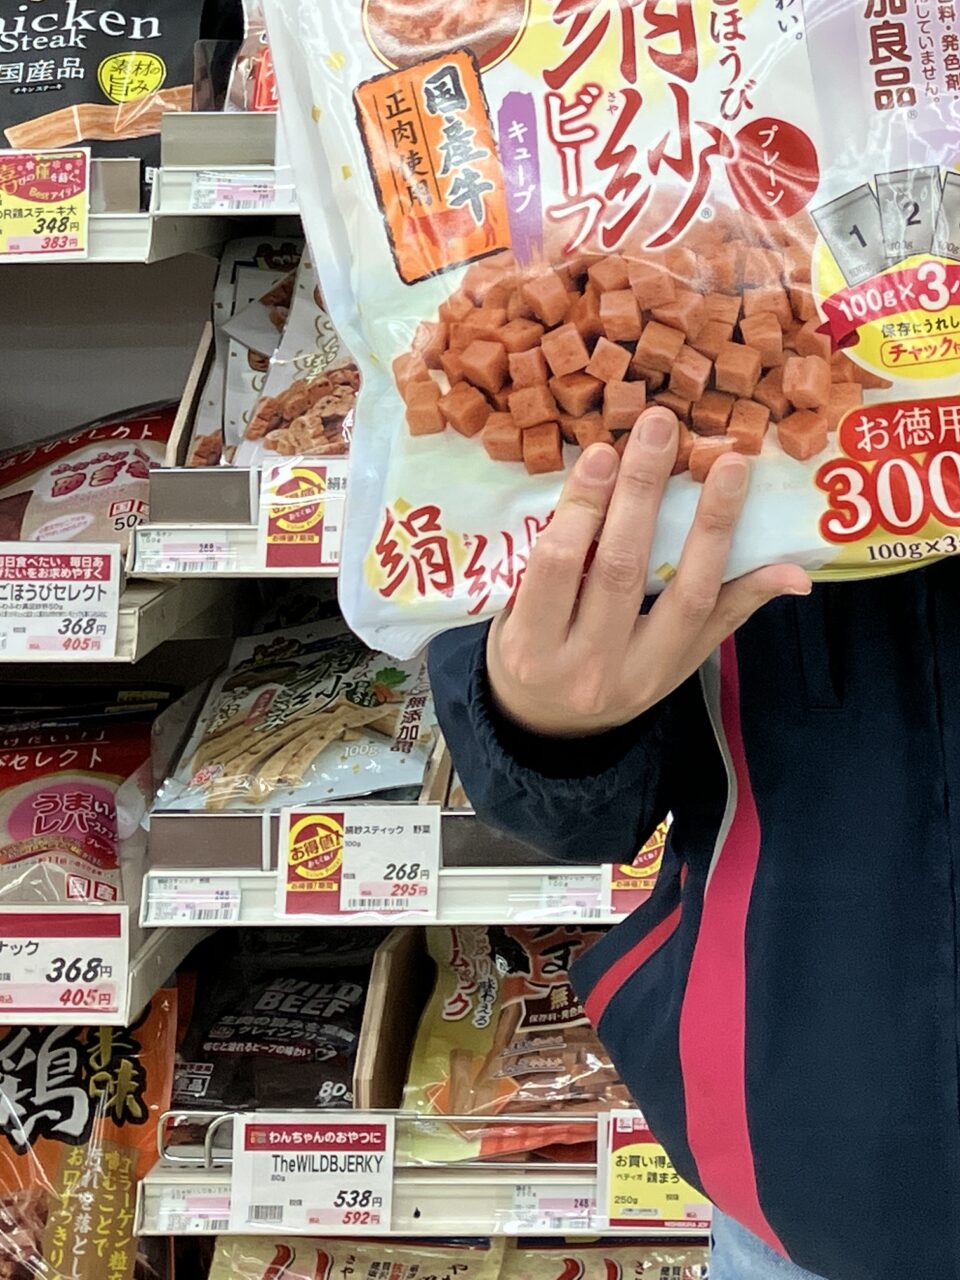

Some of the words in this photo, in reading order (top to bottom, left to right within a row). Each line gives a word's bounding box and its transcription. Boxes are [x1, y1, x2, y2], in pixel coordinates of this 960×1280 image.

[384, 88, 434, 209] 正肉使用
[422, 64, 495, 225] 国産牛
[506, 120, 538, 214] キューブ
[544, 82, 606, 254] ビーフ
[757, 126, 788, 207] プレーン
[903, 199, 923, 227] 2
[33, 217, 80, 234] 348円
[41, 236, 78, 249] 383円
[849, 223, 869, 250] 1
[58, 618, 107, 635] 368円
[63, 638, 101, 651] 405円
[344, 743, 378, 757] 100g
[413, 825, 431, 834] 野菜
[383, 863, 430, 881] 268円
[390, 883, 428, 897] 295円
[45, 957, 112, 983] 368円
[59, 988, 112, 1006] 405円
[254, 991, 350, 1018] BEEF
[270, 1131, 381, 1144] わんちゃんのおやつに
[272, 1154, 383, 1173] TheWILDBJERKY
[333, 1190, 382, 1208] 538円
[614, 1195, 638, 1204] 250g
[342, 1211, 380, 1225] 592円
